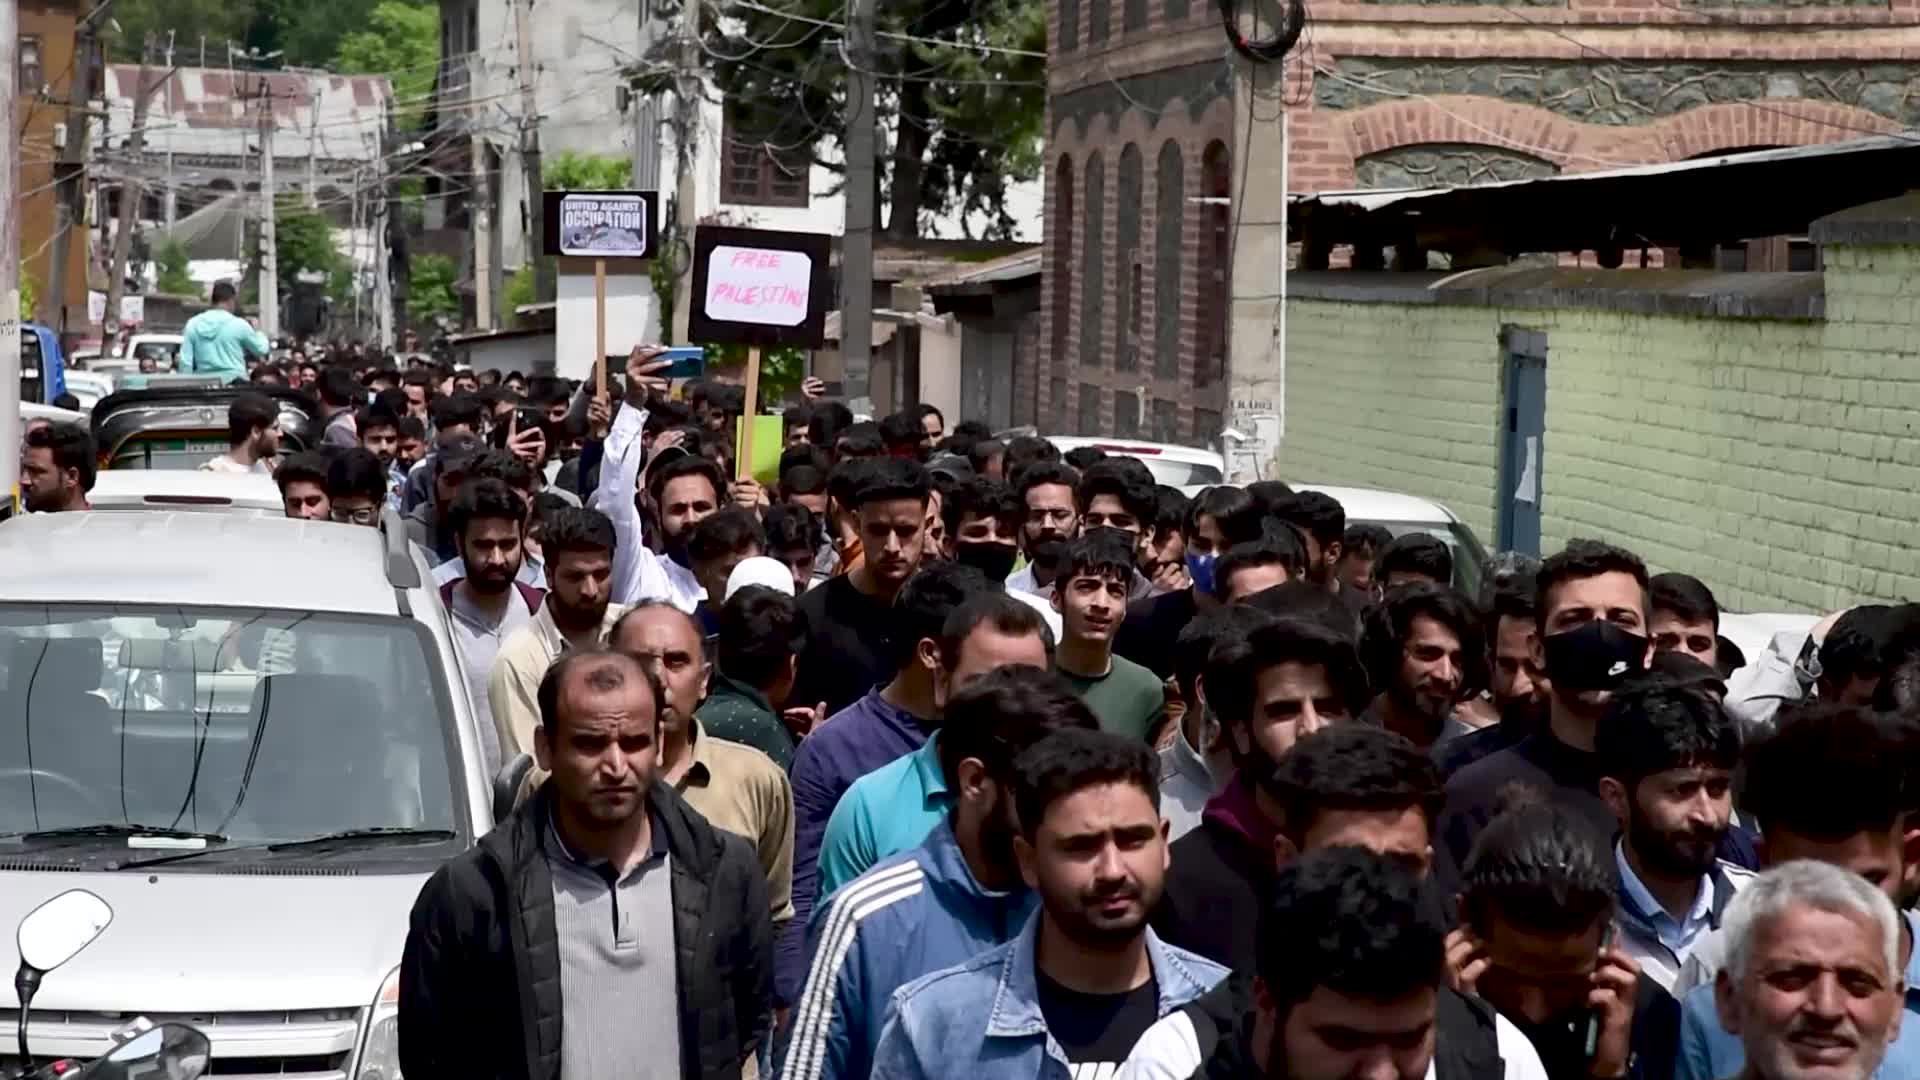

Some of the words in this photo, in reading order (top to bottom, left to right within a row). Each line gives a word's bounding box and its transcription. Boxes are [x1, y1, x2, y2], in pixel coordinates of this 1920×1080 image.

[565, 201, 600, 211] UNITED
[601, 202, 640, 211] AGAINST
[564, 210, 641, 229] OCCUPATION
[731, 250, 782, 268] FREE
